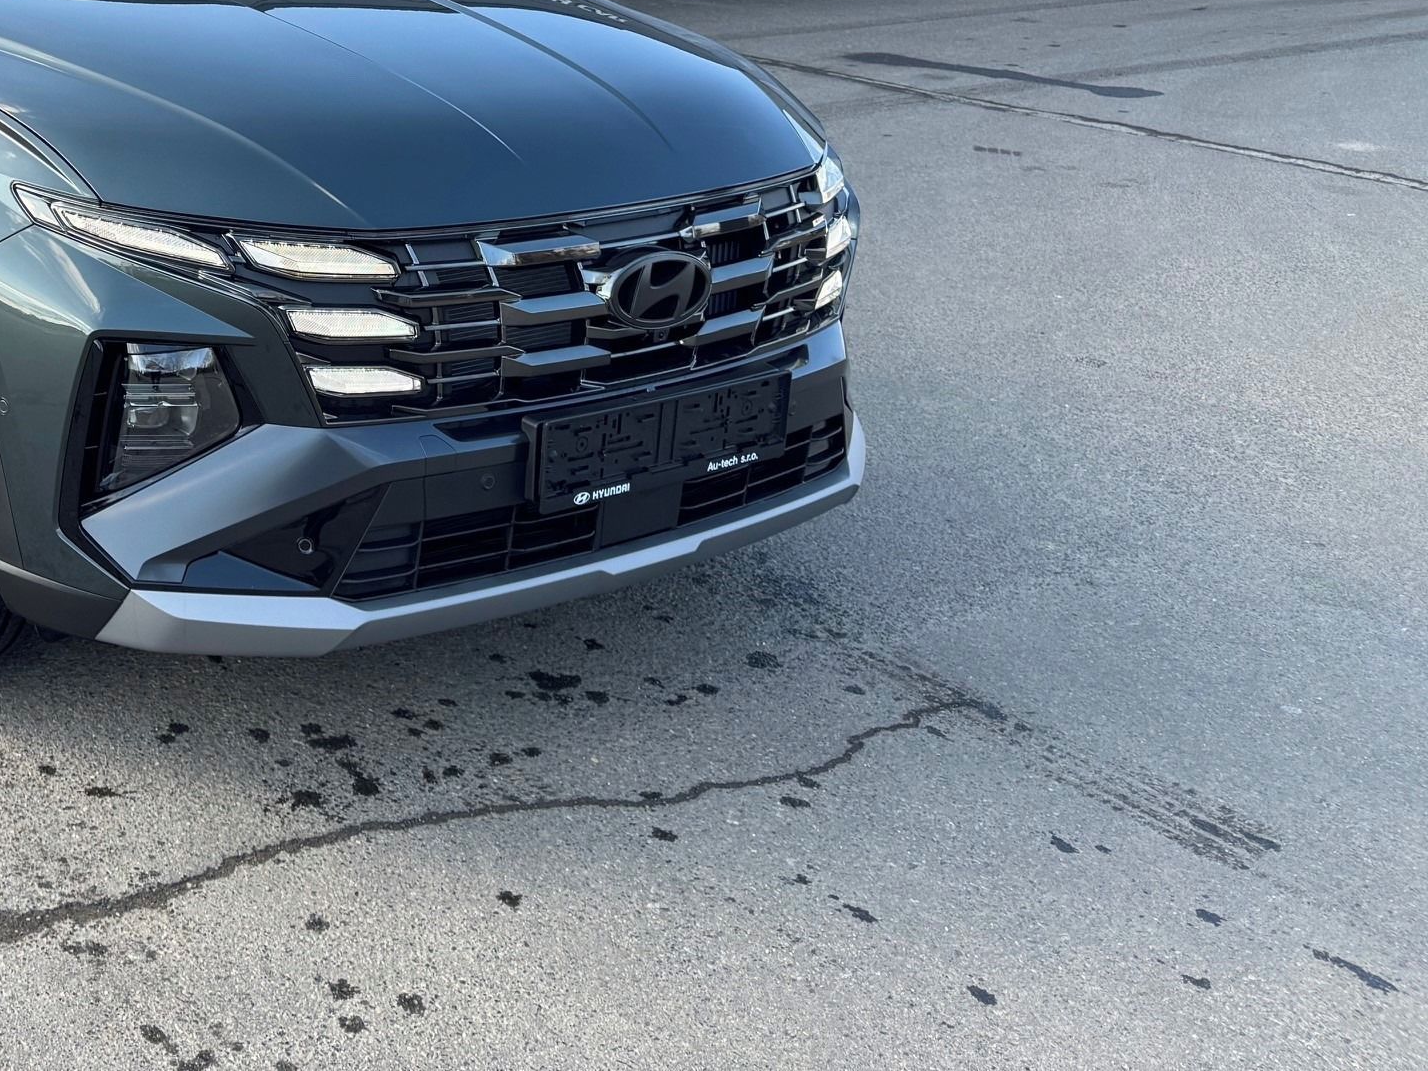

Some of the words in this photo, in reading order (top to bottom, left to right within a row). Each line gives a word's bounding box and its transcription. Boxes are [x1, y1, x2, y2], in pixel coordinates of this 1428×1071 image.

[707, 455, 738, 472] Au-tech
[740, 452, 758, 464] s.r.o.
[592, 482, 631, 500] HYUNDAI
